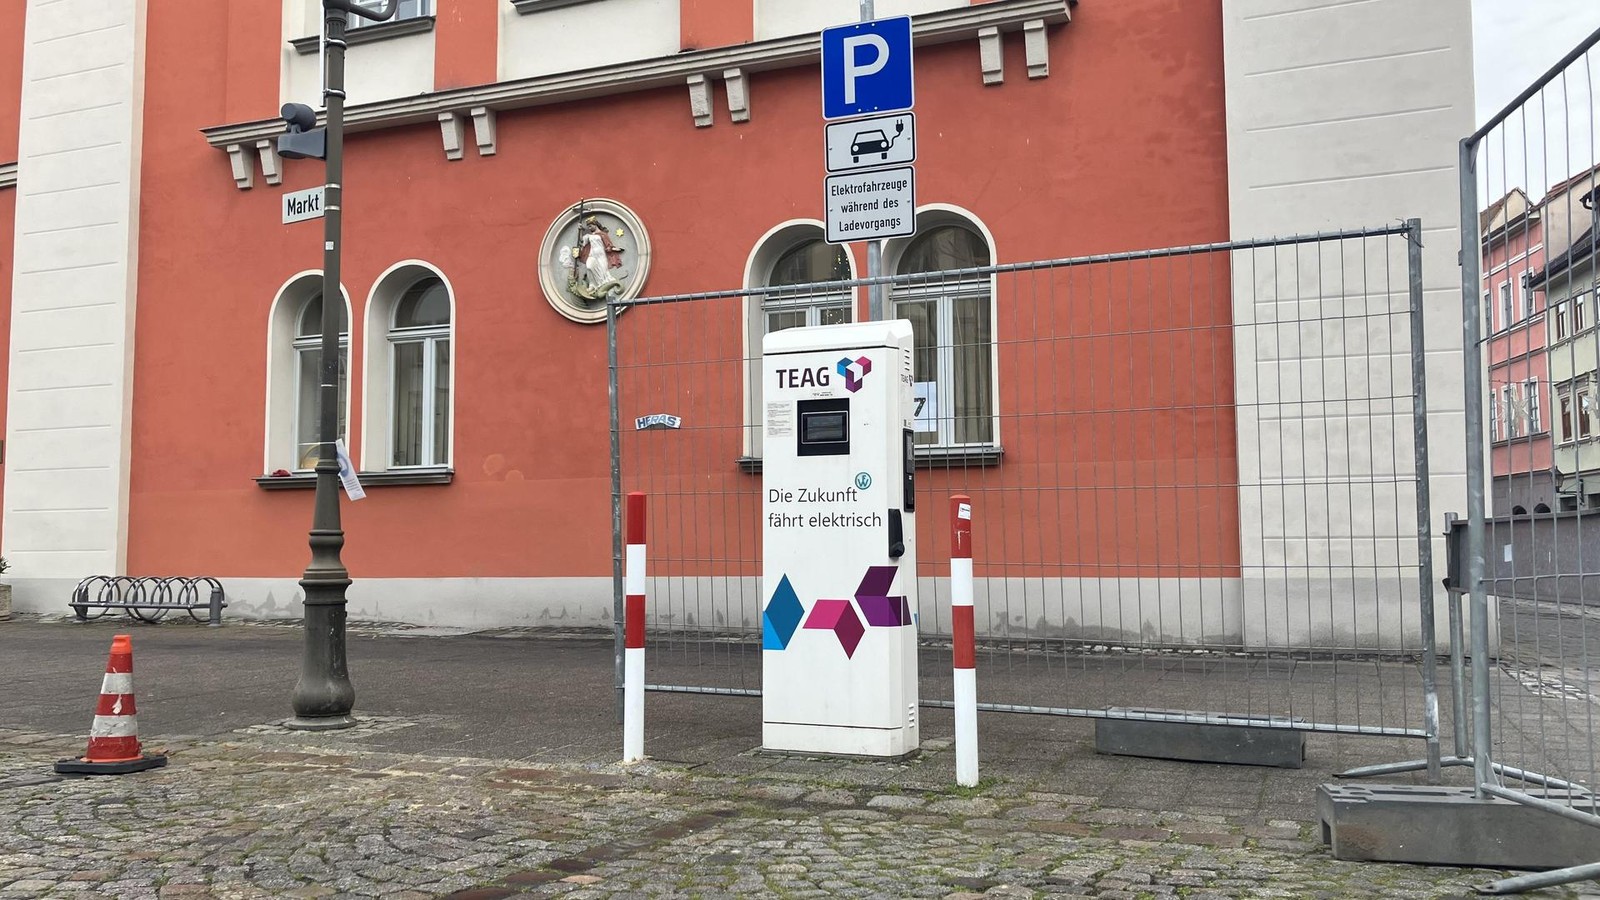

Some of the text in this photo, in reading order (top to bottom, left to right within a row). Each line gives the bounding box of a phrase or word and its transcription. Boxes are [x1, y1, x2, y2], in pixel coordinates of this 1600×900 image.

[843, 33, 890, 105] P
[831, 179, 908, 197] Elektrofahrzeuge
[287, 194, 319, 217] Markt
[841, 198, 899, 213] während des
[839, 217, 901, 232] Ladevorgangs
[775, 367, 830, 389] TEAG
[637, 414, 677, 429] HERAS
[769, 486, 858, 503] Die Zukunft
[768, 512, 882, 527] fährt elektrisch
